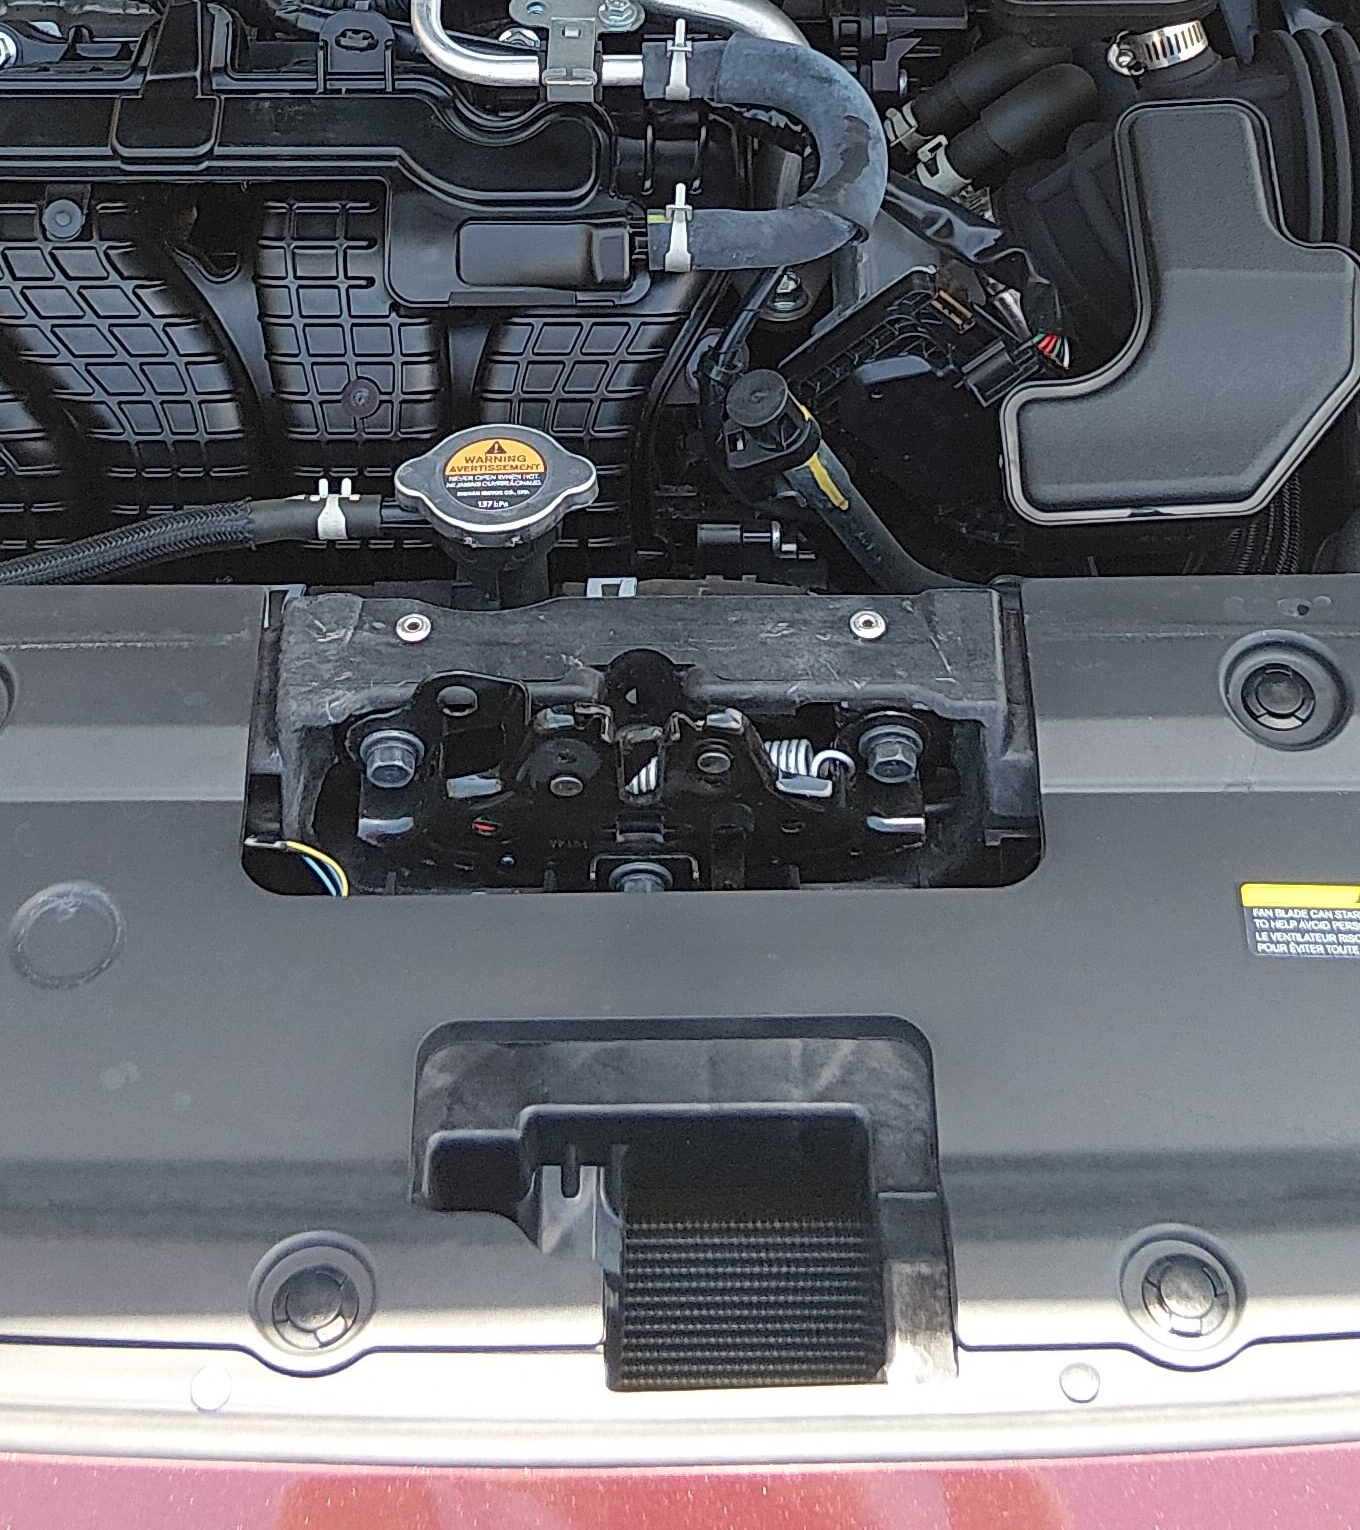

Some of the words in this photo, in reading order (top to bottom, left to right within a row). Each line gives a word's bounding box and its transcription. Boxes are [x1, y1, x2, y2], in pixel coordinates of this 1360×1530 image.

[464, 454, 526, 464] WARNING
[449, 463, 541, 473] AVERTISSEMENT
[1253, 908, 1273, 918] FAN
[1275, 908, 1309, 919] BLADE
[1311, 909, 1333, 919] CAN
[1253, 919, 1269, 929] TO
[1271, 919, 1297, 929] HELP
[1299, 920, 1331, 930] AVOID
[1255, 932, 1268, 942] LE
[1270, 932, 1337, 943] VENTILATEUR
[1257, 943, 1287, 953] POUR
[1290, 942, 1324, 954] ÉVITER
[1326, 944, 1359, 955] TOUTE
